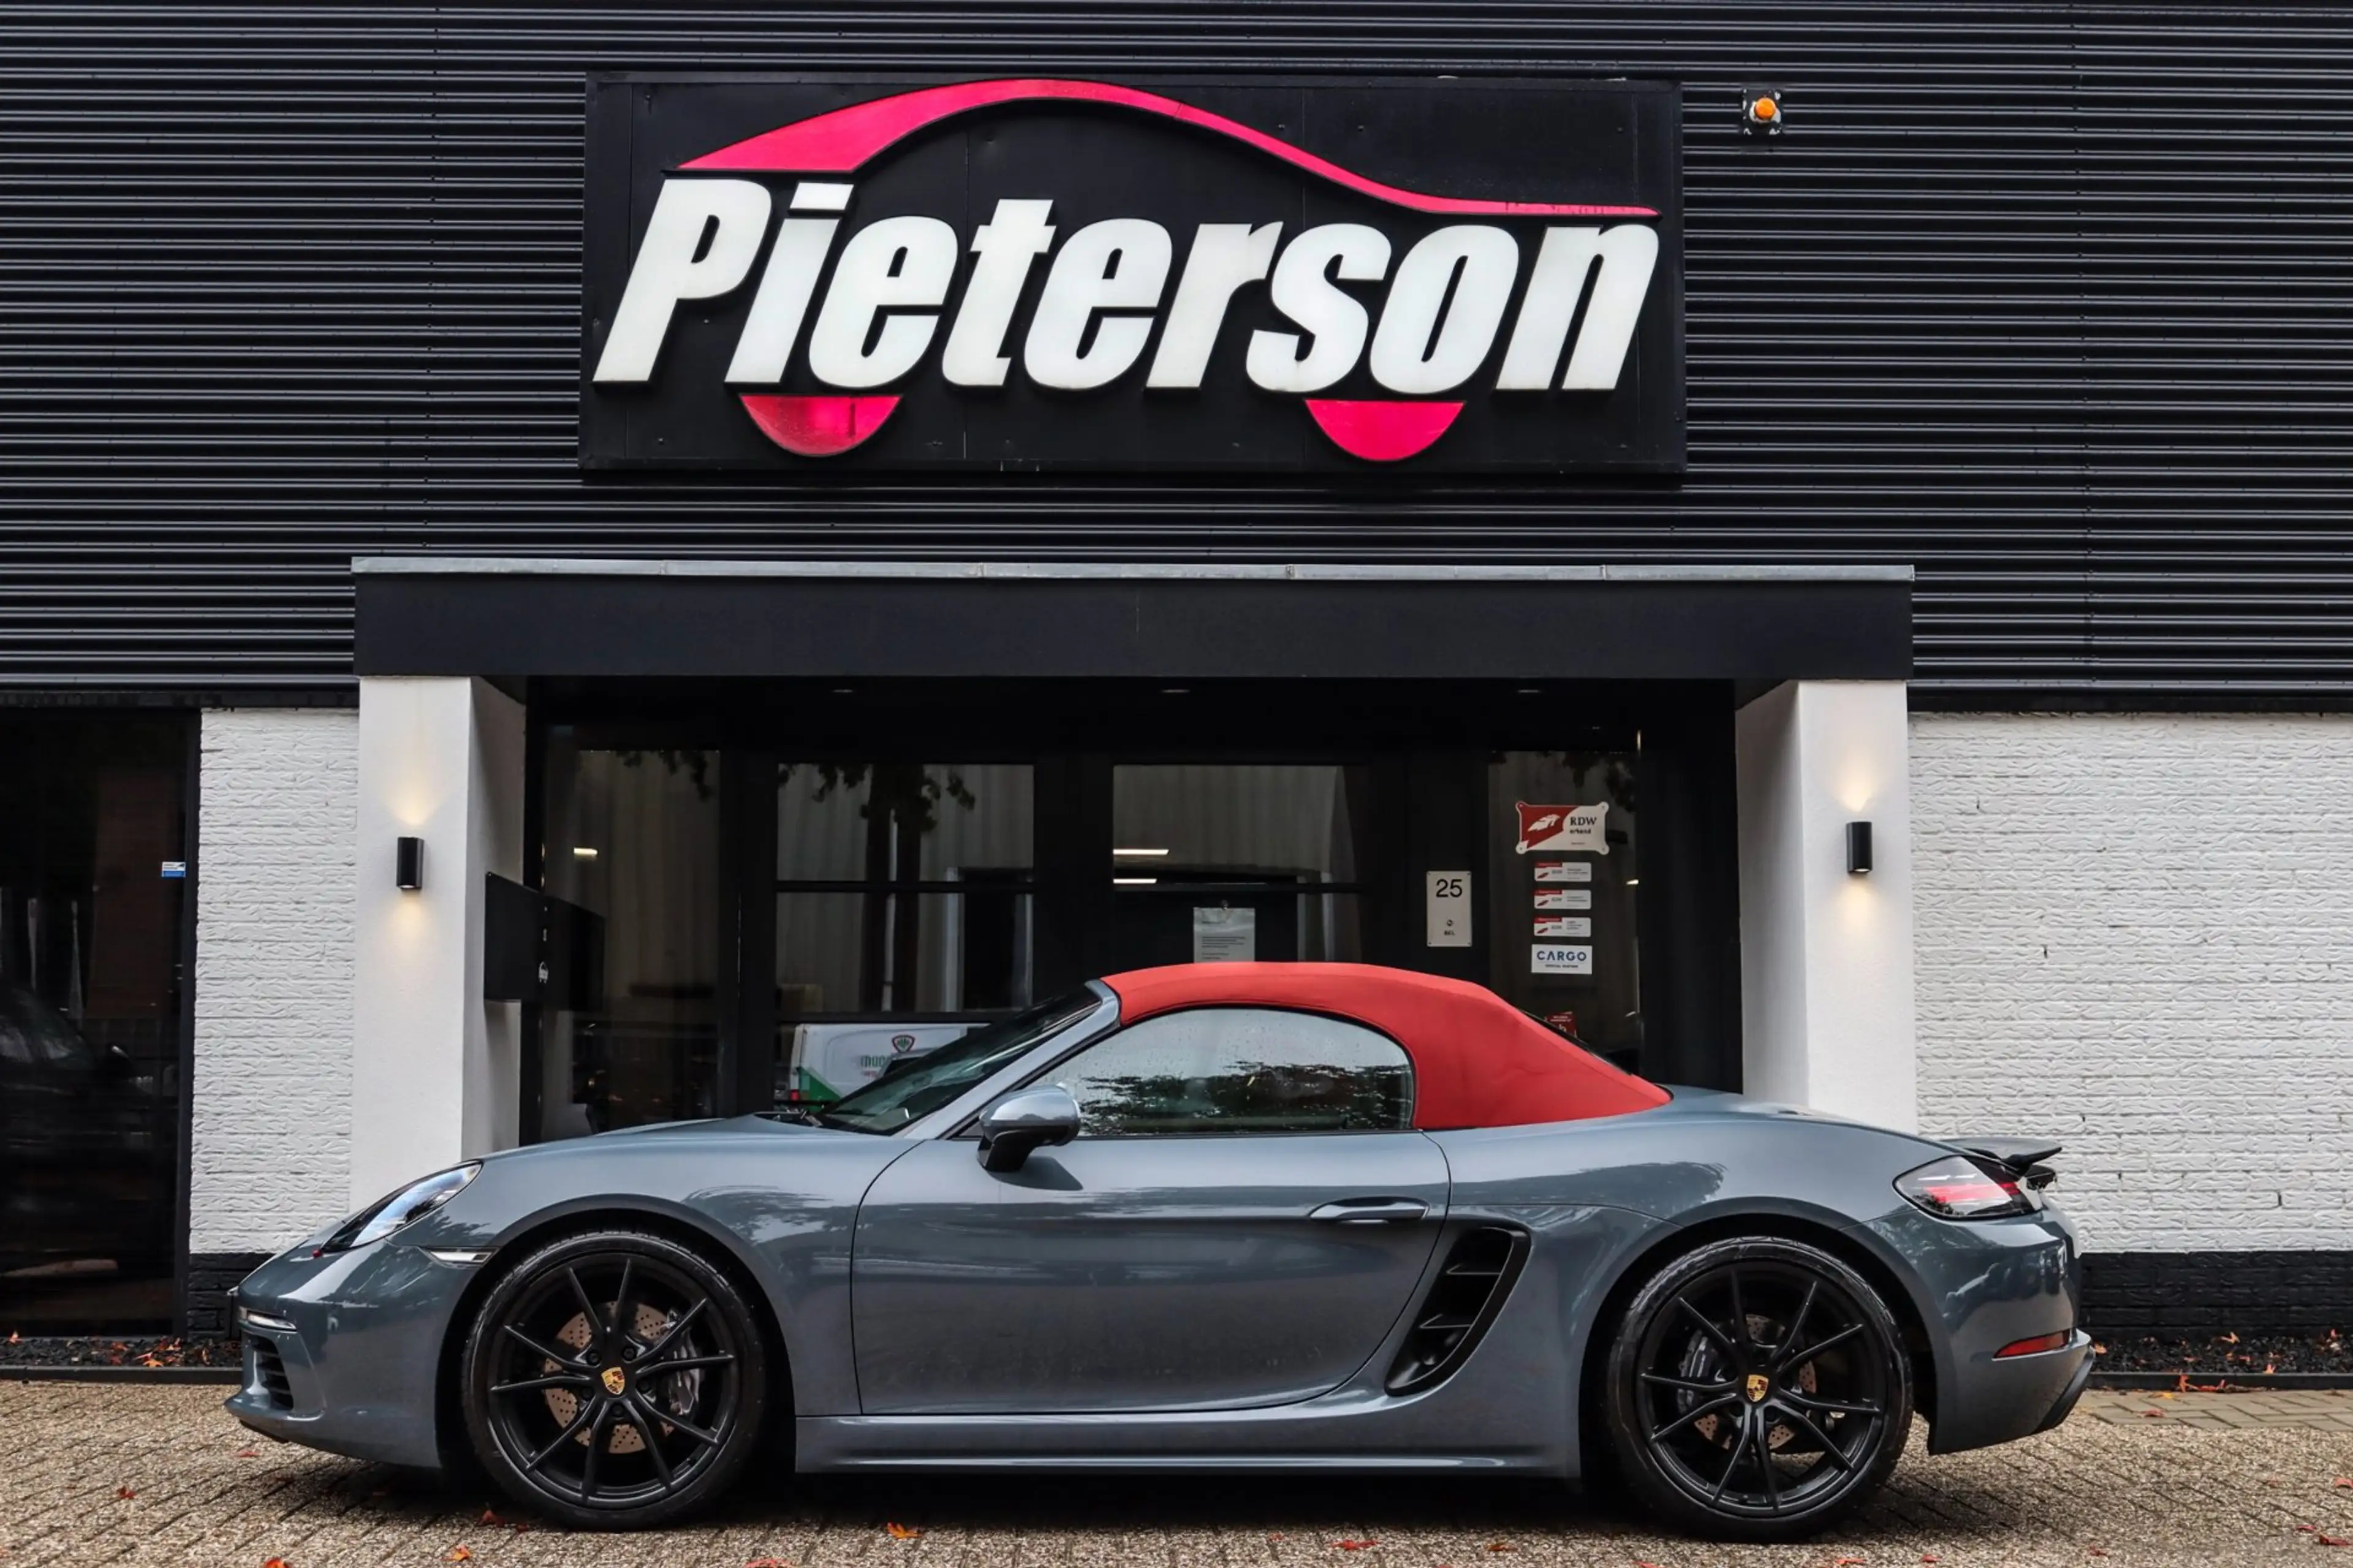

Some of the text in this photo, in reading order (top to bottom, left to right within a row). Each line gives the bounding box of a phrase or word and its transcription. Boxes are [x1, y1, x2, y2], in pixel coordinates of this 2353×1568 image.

[593, 179, 1659, 394] Pieterson
[1570, 816, 1597, 826] RDW
[1436, 879, 1463, 898] 25
[1536, 950, 1587, 961] CARGO
